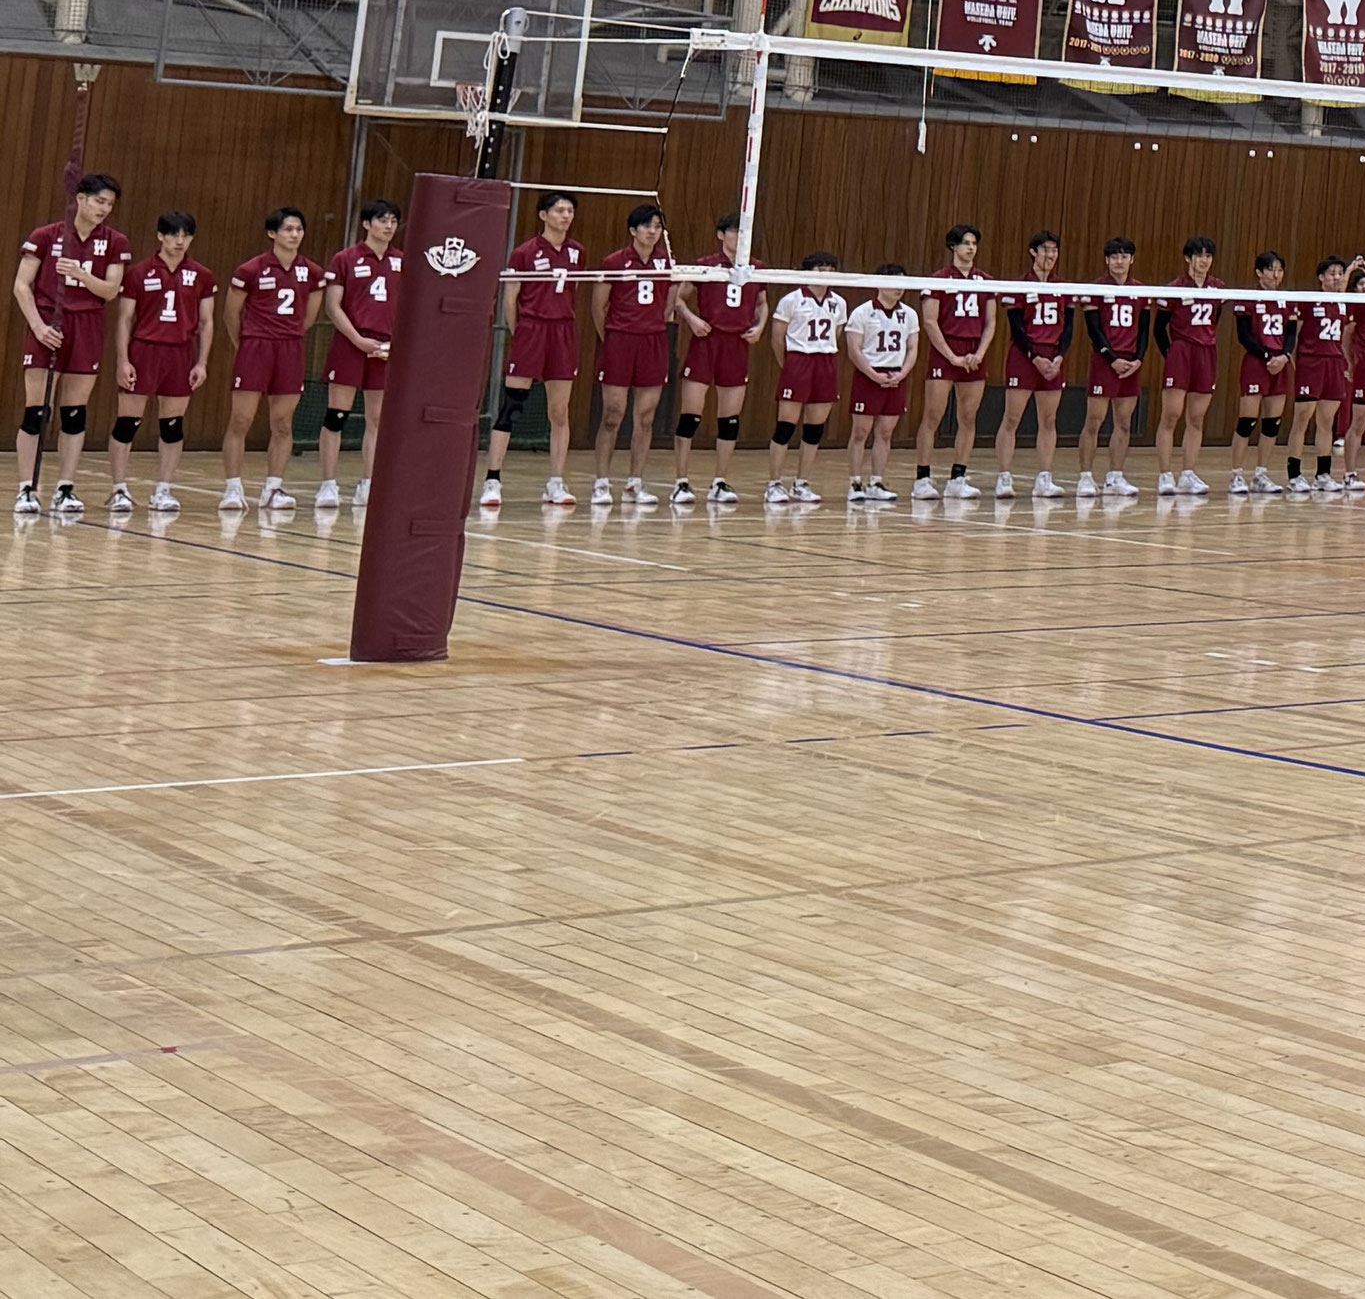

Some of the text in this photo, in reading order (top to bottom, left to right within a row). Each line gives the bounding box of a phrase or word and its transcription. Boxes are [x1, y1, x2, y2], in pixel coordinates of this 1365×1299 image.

[964, 0, 995, 19] WASEDA
[93, 239, 108, 256] W
[181, 269, 198, 287] W
[295, 266, 309, 282] W
[552, 268, 567, 293] 7
[369, 275, 387, 302] 4
[638, 280, 654, 304] 8
[726, 283, 742, 307] 9
[160, 290, 177, 322] 1
[277, 288, 295, 315] 2
[954, 292, 979, 318] 14
[1032, 302, 1058, 325] 15
[1109, 304, 1133, 327] 16
[1190, 303, 1213, 326] 22
[1262, 314, 1284, 336] 23
[807, 318, 831, 341] 12
[1319, 317, 1341, 341] 24
[876, 330, 901, 352] 13
